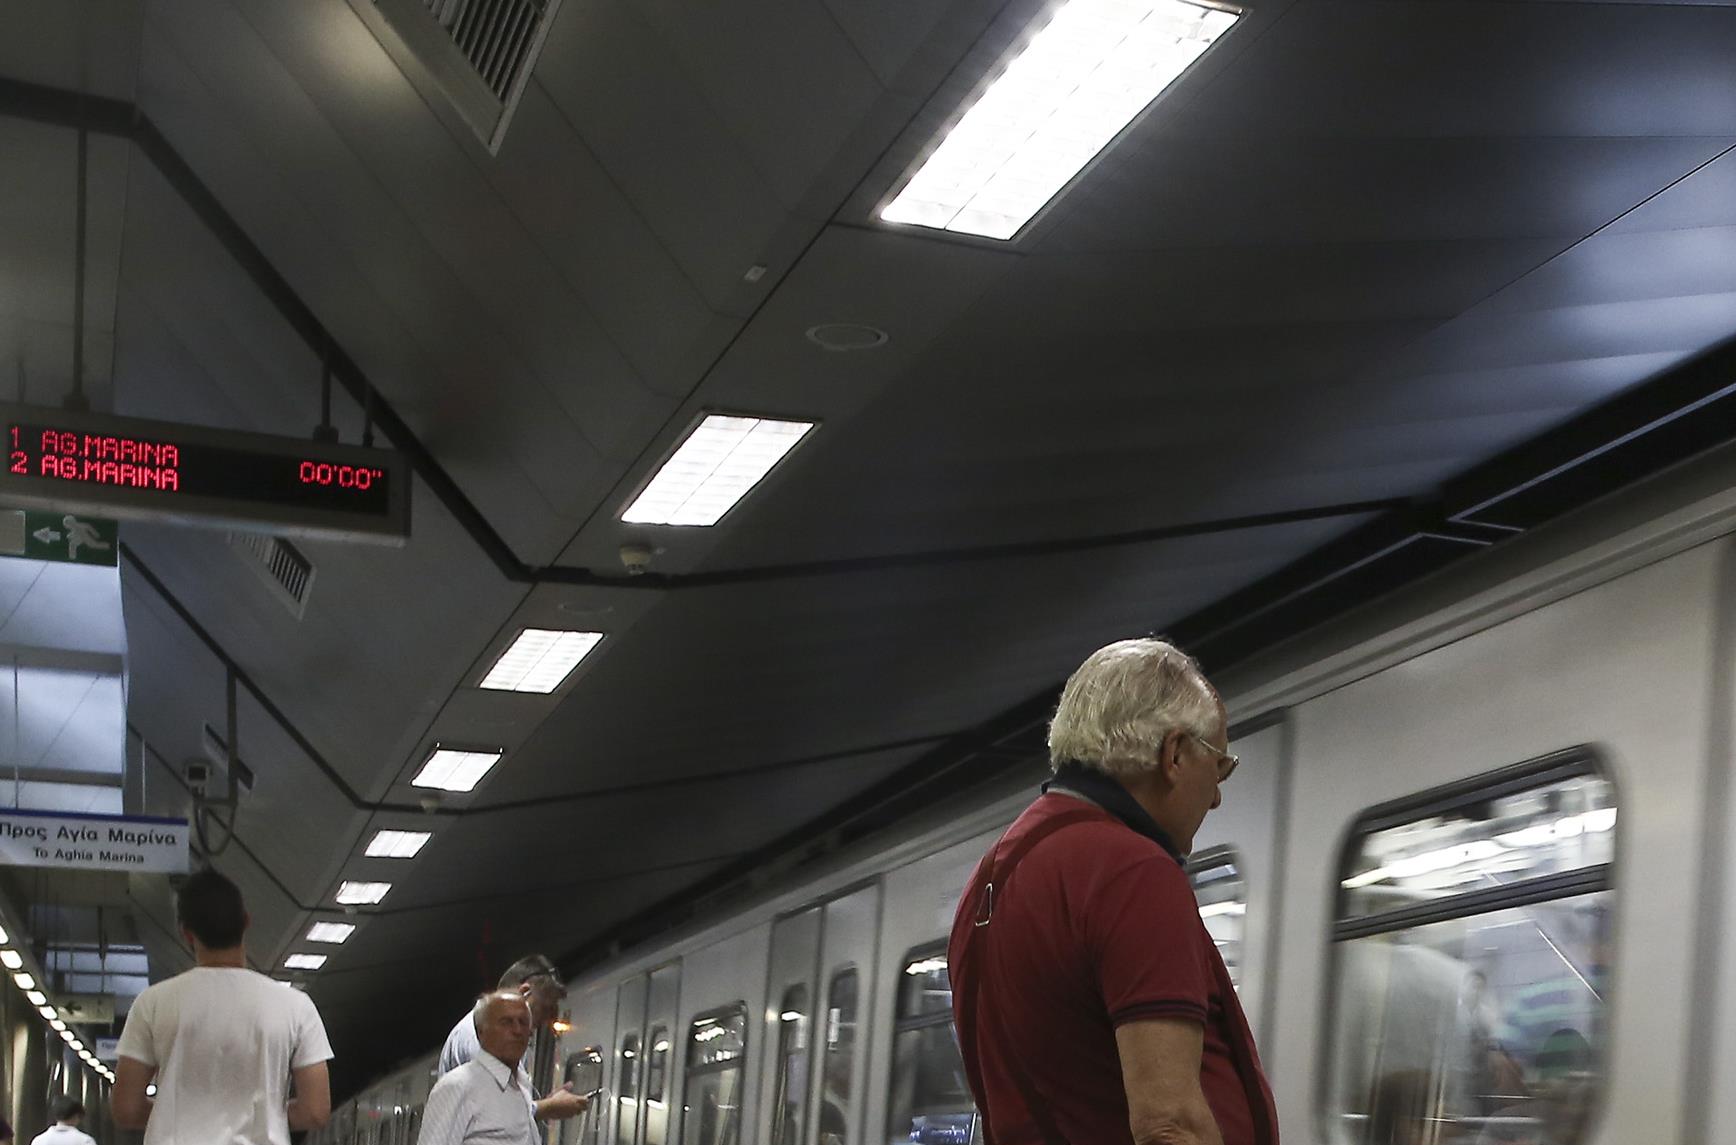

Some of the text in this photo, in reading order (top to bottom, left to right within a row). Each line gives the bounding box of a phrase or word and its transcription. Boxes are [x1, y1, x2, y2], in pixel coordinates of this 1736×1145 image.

[10, 426, 19, 449] 1
[41, 429, 179, 467] AG.MARINA
[10, 451, 179, 491] 2 AG.MARINA
[56, 825, 98, 842] Αγία
[108, 827, 177, 847] Μαρίνα
[33, 847, 145, 864] To Aghia Marina
